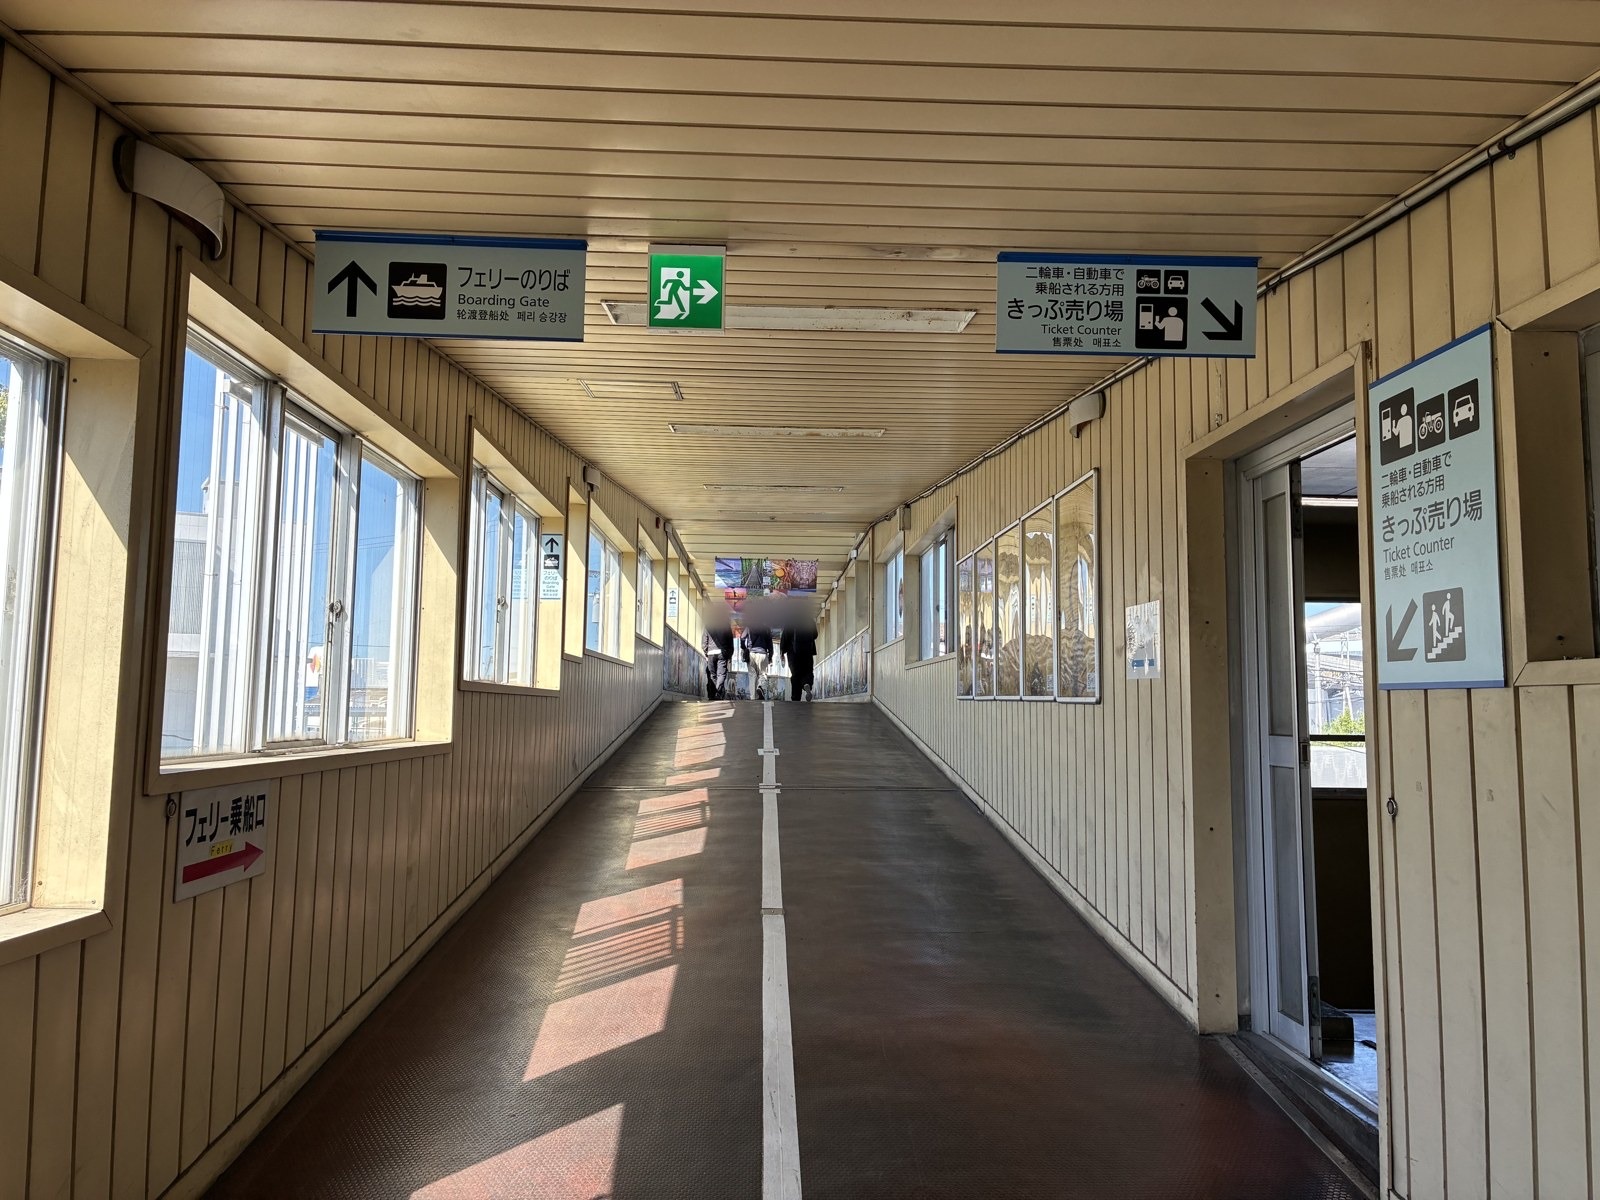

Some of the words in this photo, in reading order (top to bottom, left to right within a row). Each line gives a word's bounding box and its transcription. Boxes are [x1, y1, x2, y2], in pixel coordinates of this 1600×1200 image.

[457, 266, 571, 292] フェリーのりば
[1025, 266, 1125, 280] 二輪車・自動車で
[1035, 282, 1125, 297] 乗船される方用
[458, 294, 516, 309] Boarding
[519, 296, 550, 308] Gate
[456, 310, 509, 322] 轮渡登船处
[538, 311, 568, 324] 승강장
[1007, 298, 1124, 322] きっぷ売り場
[1041, 324, 1074, 336] Ticket
[1077, 324, 1122, 337] Counter
[1052, 336, 1083, 348] 售票处
[1092, 337, 1122, 348] 매표소
[1381, 450, 1453, 490] 二輪車・自動車で
[1381, 474, 1445, 509] 乗船される方用
[1382, 489, 1483, 543] きっぷ売り場
[1383, 545, 1411, 563] Ticket
[1413, 536, 1455, 557] Counter
[1384, 563, 1407, 581] 售票处
[185, 794, 266, 848] フェリー乗船口
